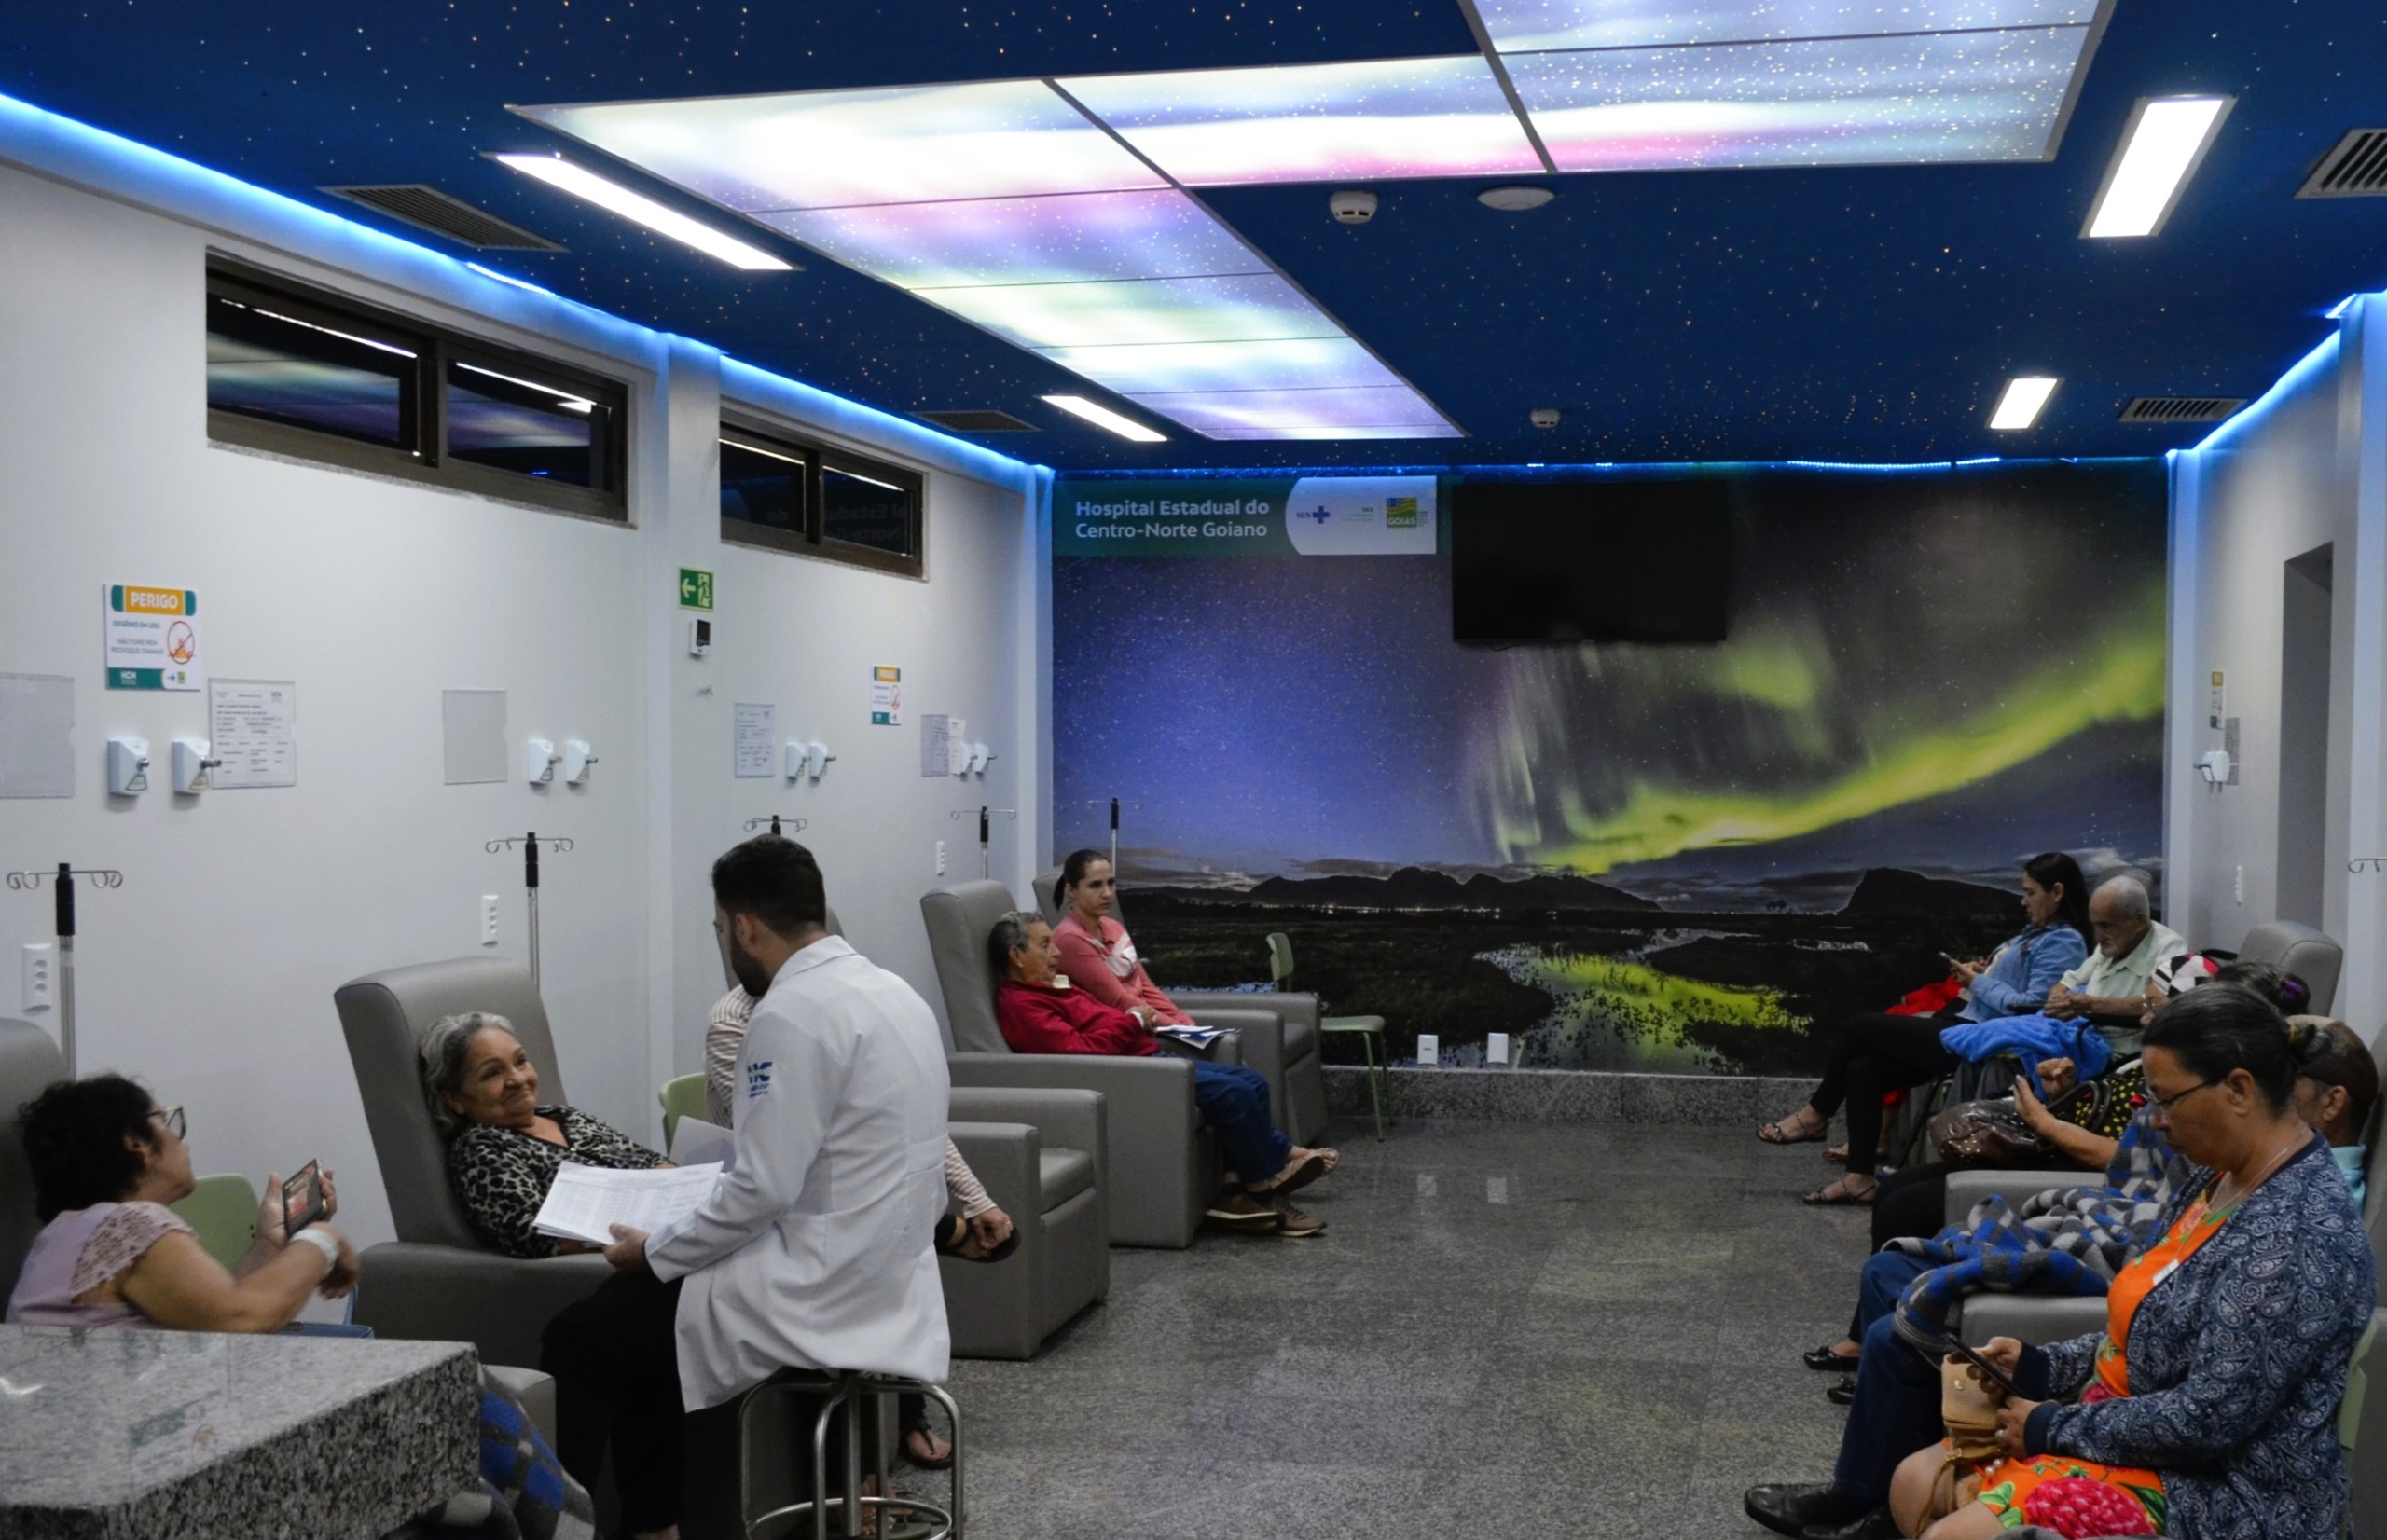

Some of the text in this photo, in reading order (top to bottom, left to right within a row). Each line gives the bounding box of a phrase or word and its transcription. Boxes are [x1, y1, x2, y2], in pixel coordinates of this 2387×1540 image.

[1075, 499, 1270, 518] Hospital Estadual do
[1075, 522, 1267, 539] Centro-Norte Goiano
[131, 592, 179, 610] PERIGO
